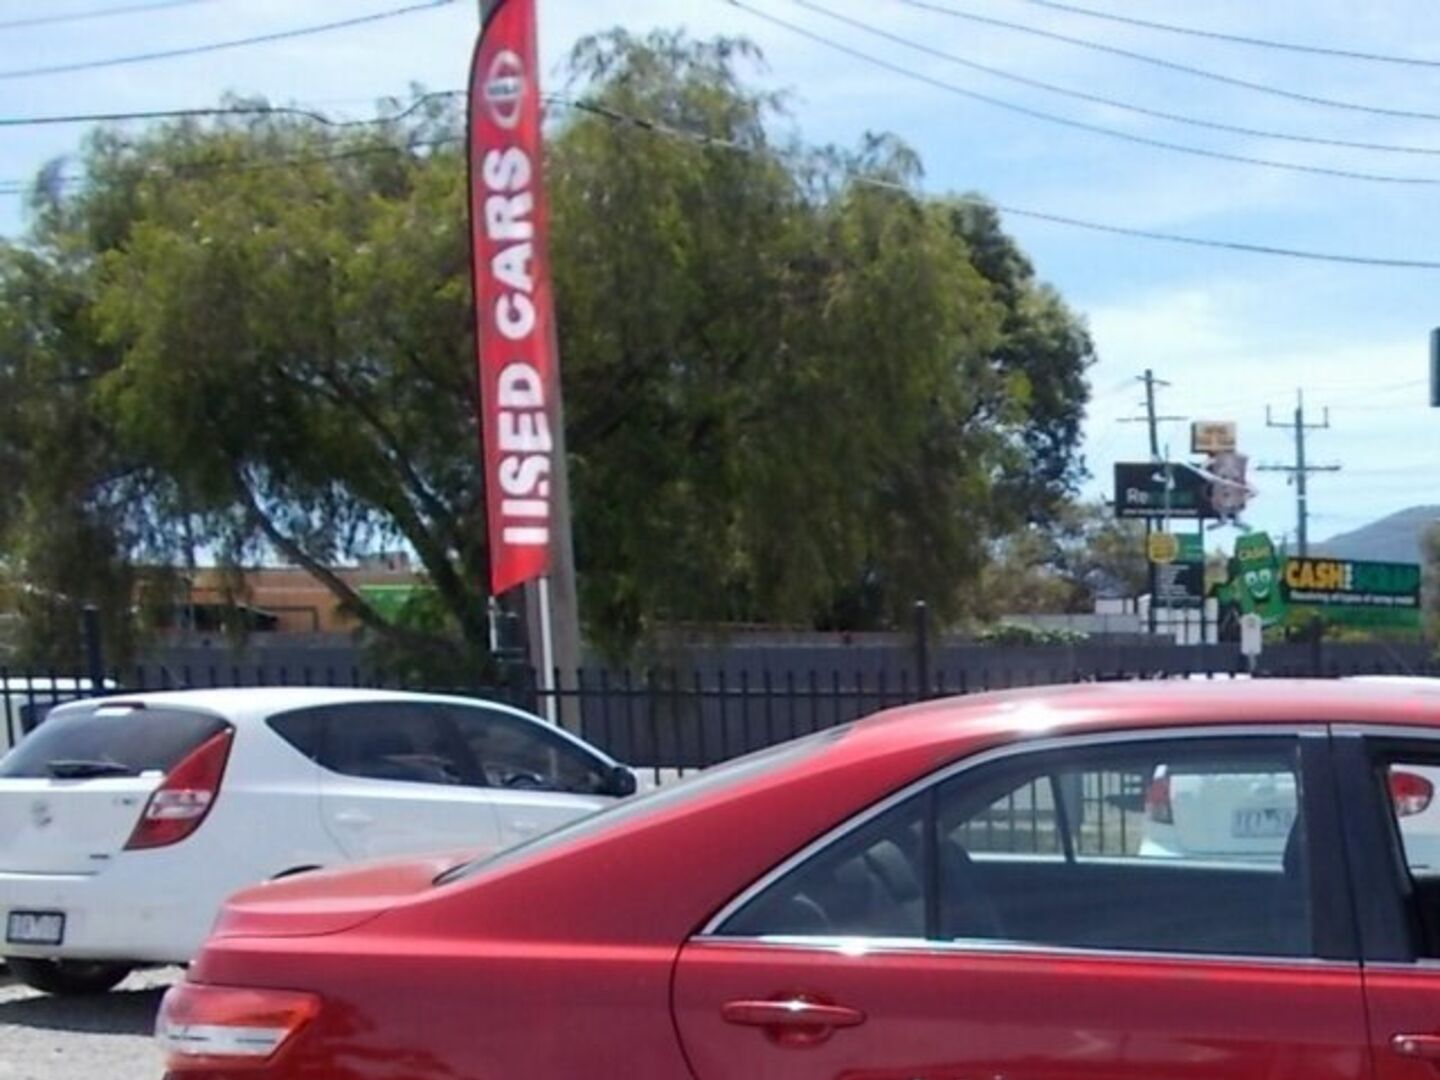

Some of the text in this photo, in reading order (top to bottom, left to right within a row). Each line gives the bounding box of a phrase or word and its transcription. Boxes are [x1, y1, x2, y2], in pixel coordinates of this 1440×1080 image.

[483, 146, 537, 340] CARS
[499, 362, 552, 545] USED
[1285, 559, 1346, 590] CASH
